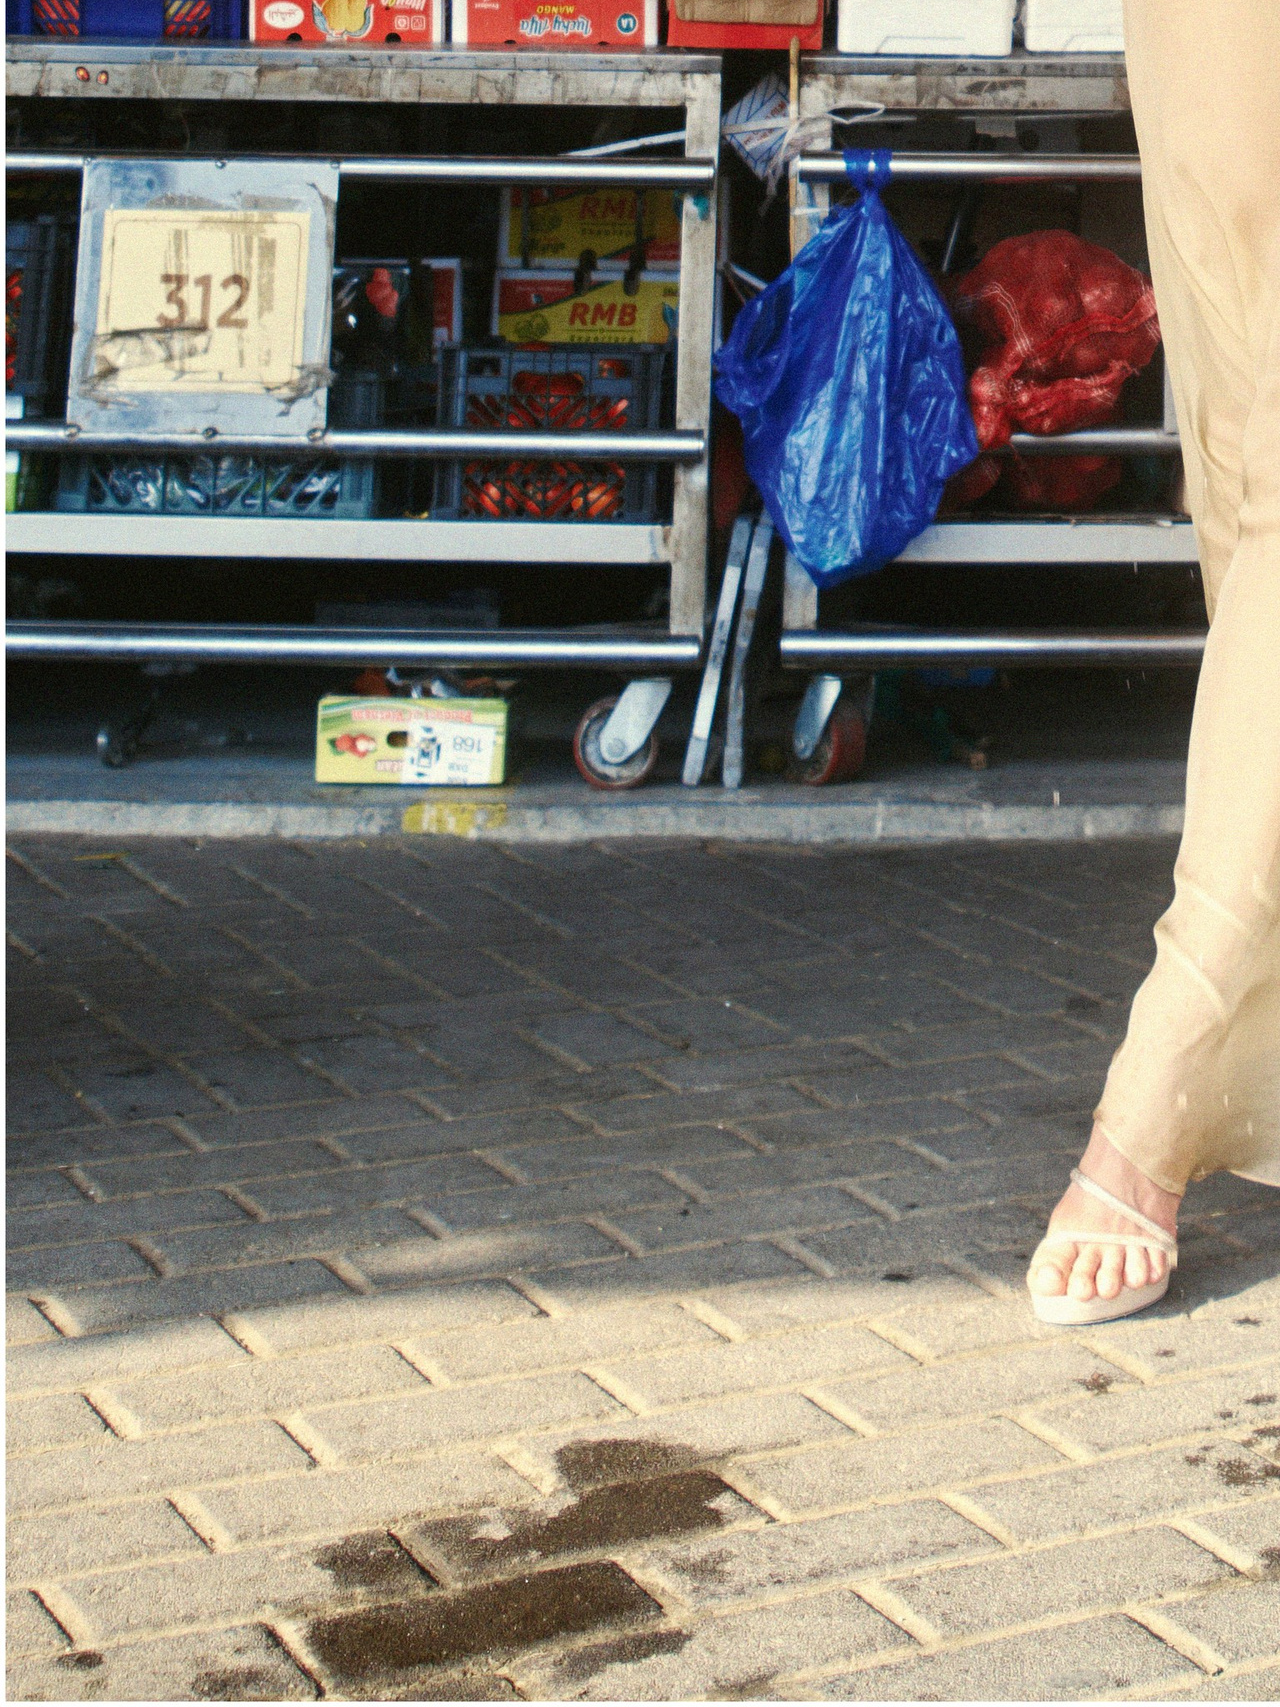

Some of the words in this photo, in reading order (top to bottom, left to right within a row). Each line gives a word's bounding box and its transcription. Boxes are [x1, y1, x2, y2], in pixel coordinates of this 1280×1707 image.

[535, 4, 575, 15] MANGO
[519, 15, 550, 37] Alfa
[552, 15, 592, 37] Lucky
[620, 17, 633, 31] LA
[156, 273, 250, 330] 312
[569, 302, 638, 326] RMB
[452, 736, 483, 754] 168
